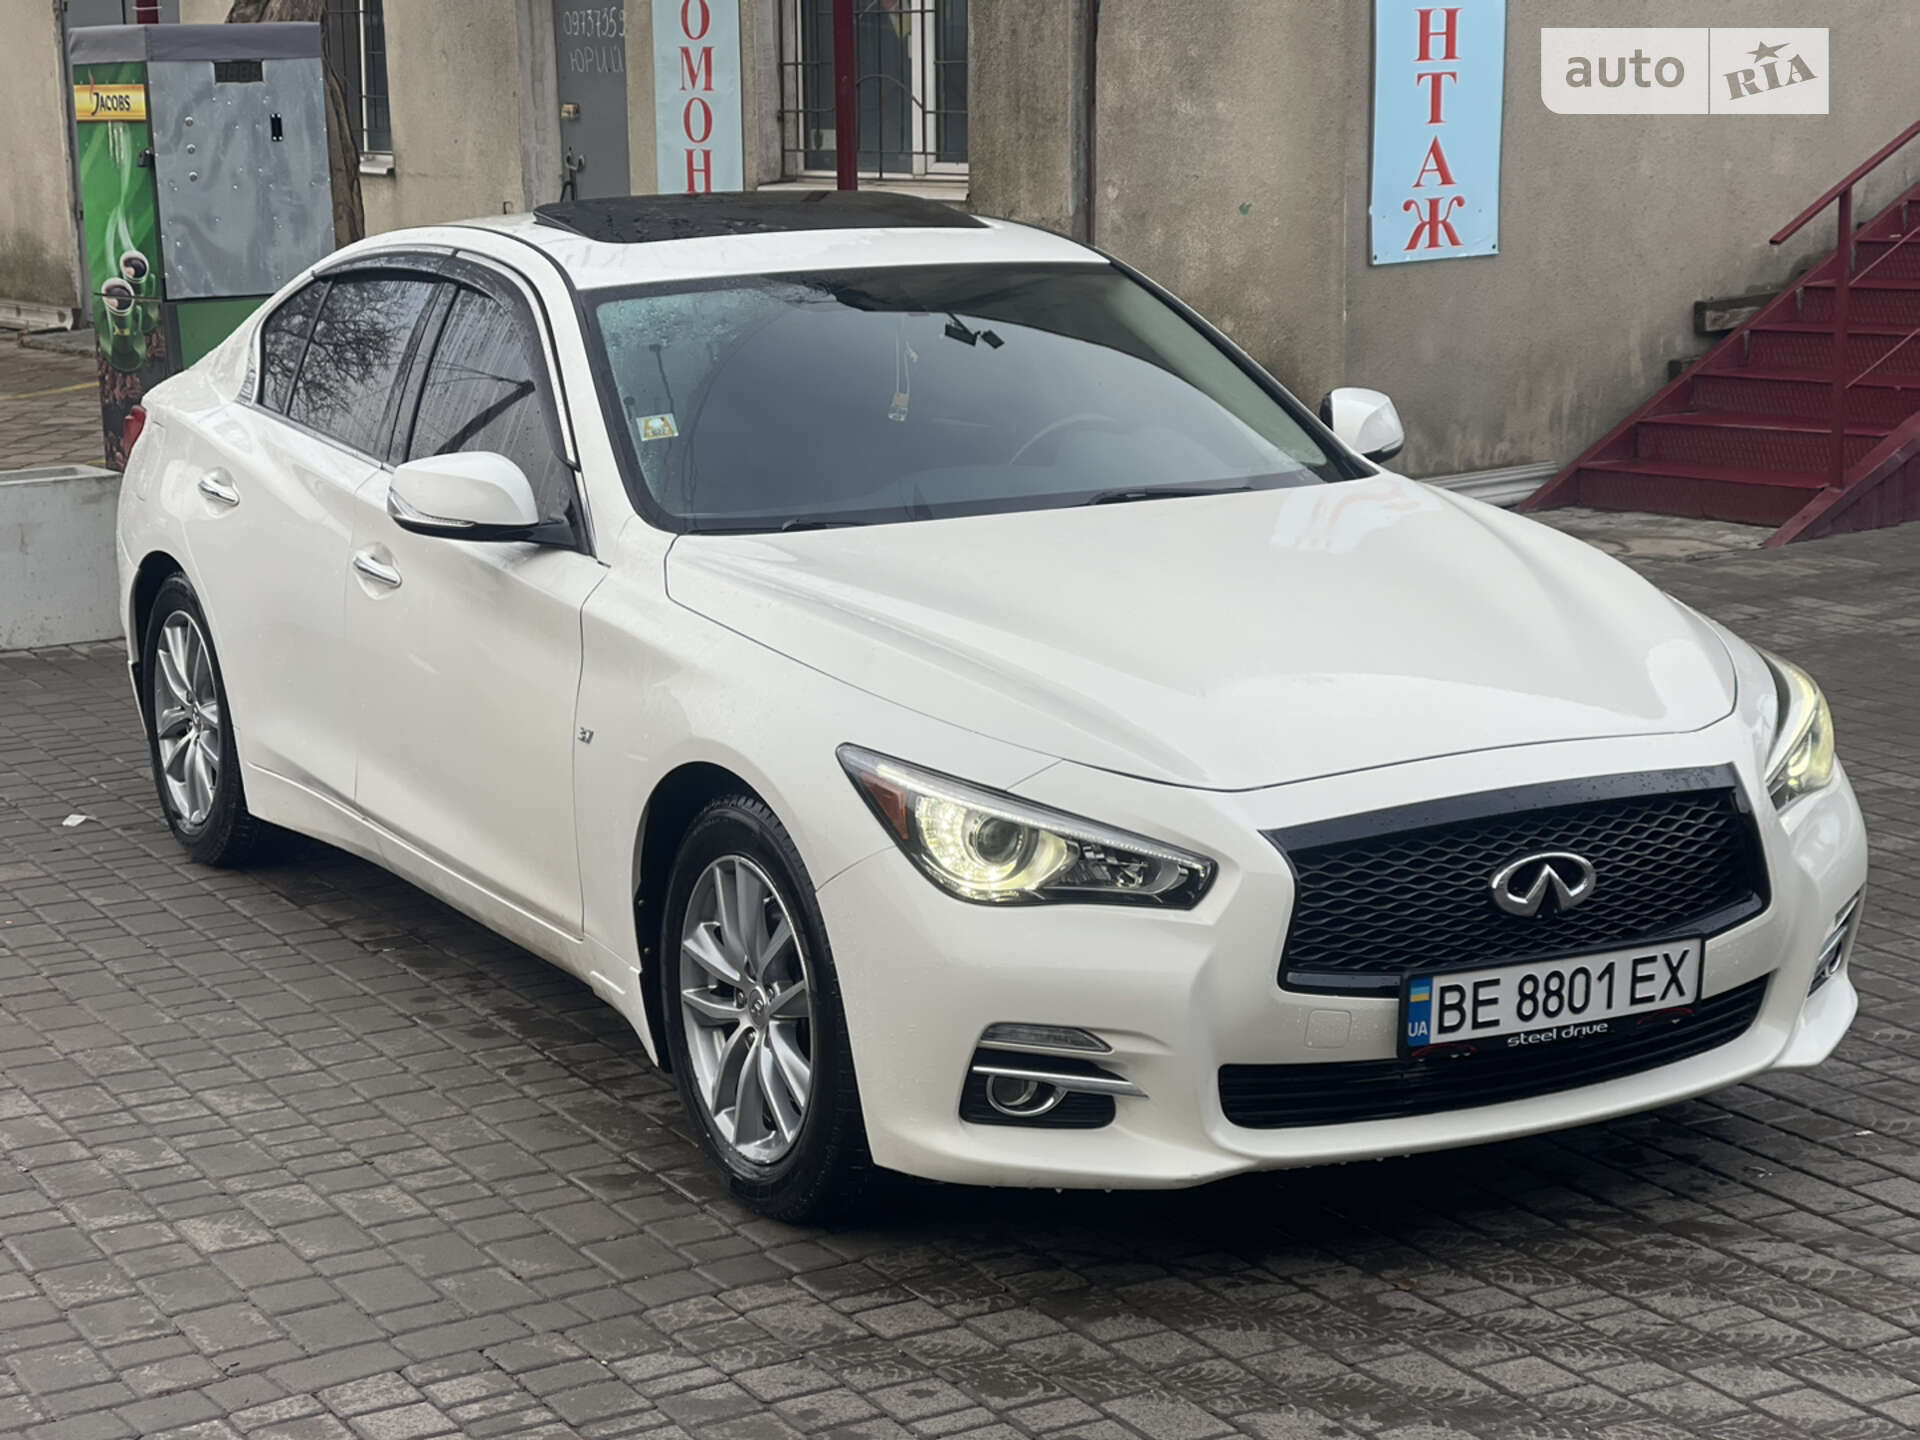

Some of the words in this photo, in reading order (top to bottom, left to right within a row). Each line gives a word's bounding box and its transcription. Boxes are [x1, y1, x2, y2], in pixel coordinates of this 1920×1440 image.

[1402, 7, 1465, 251] НТАЖ
[1437, 978, 1500, 1035] BE
[1516, 961, 1615, 1023] 8801
[1629, 949, 1690, 1006] EX
[1408, 1020, 1428, 1038] UA
[1507, 1027, 1557, 1047] steel
[1561, 1021, 1608, 1040] drive
